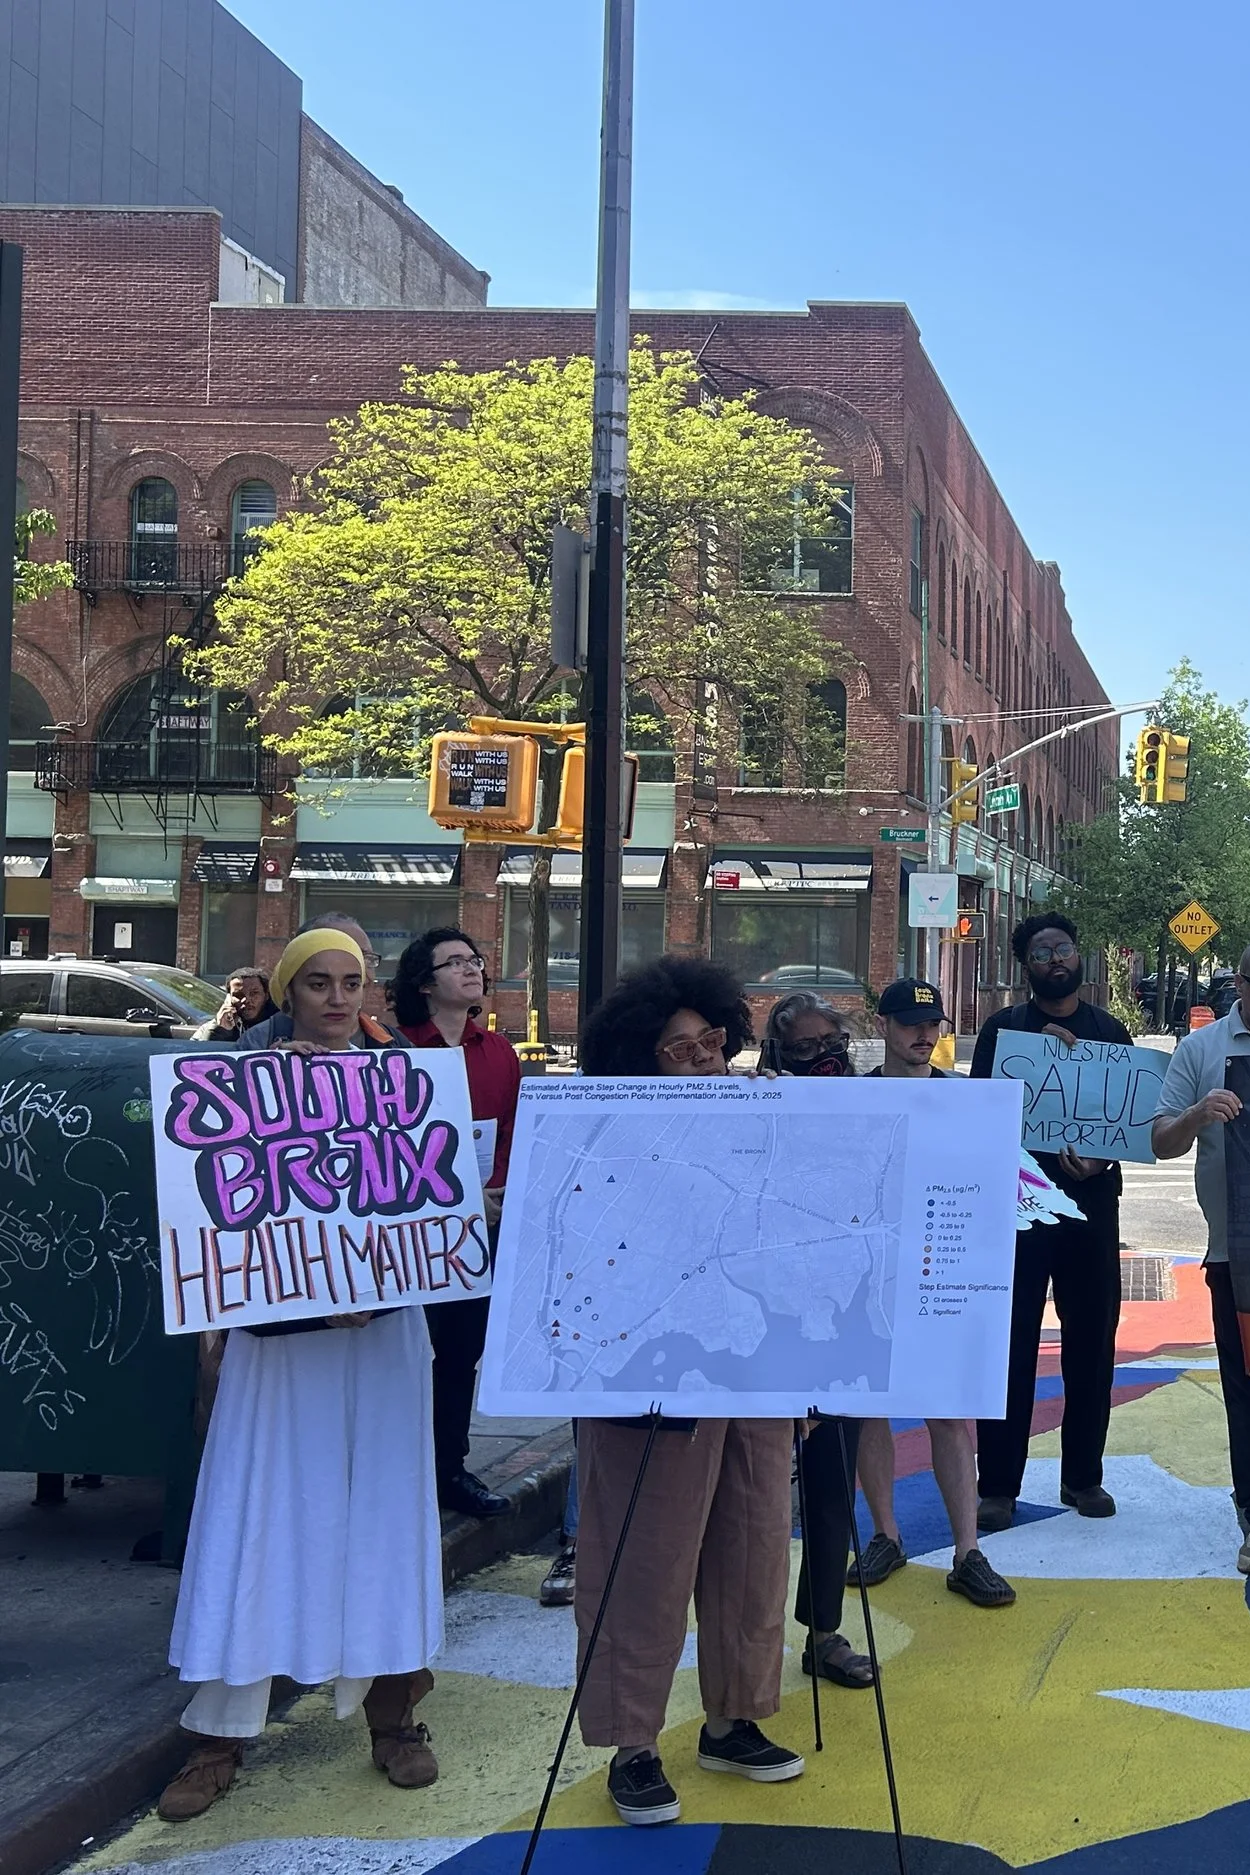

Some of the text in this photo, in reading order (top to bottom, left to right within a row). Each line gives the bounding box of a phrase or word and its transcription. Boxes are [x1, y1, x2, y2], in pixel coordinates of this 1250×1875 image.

[889, 830, 920, 838] Bruckner
[1174, 924, 1213, 936] OUTLET
[1186, 912, 1201, 922] NO
[1043, 1038, 1132, 1064] NUESTRA
[164, 1050, 434, 1150] SOUTH
[520, 1083, 560, 1092] Estimated
[561, 1083, 594, 1093] Average
[596, 1083, 615, 1093] Step
[616, 1083, 648, 1093] Change
[658, 1083, 684, 1093] Hourly
[686, 1083, 712, 1091] PM2.5
[714, 1083, 742, 1092] Levels,
[520, 1092, 534, 1100] Pre
[536, 1092, 563, 1100] Versus
[564, 1092, 584, 1100] Post
[584, 1092, 629, 1102] Congestion
[630, 1092, 655, 1102] Policy
[656, 1092, 717, 1102] Implementation
[718, 1092, 751, 1102] January
[762, 1092, 782, 1100] 2025
[1000, 1054, 1164, 1128] SALUD
[1023, 1120, 1129, 1149] MPORTA
[194, 1120, 464, 1232] BRONX
[169, 1217, 339, 1327] HEALTH
[337, 1214, 489, 1304] MATTERS
[968, 1284, 1009, 1292] Significance
